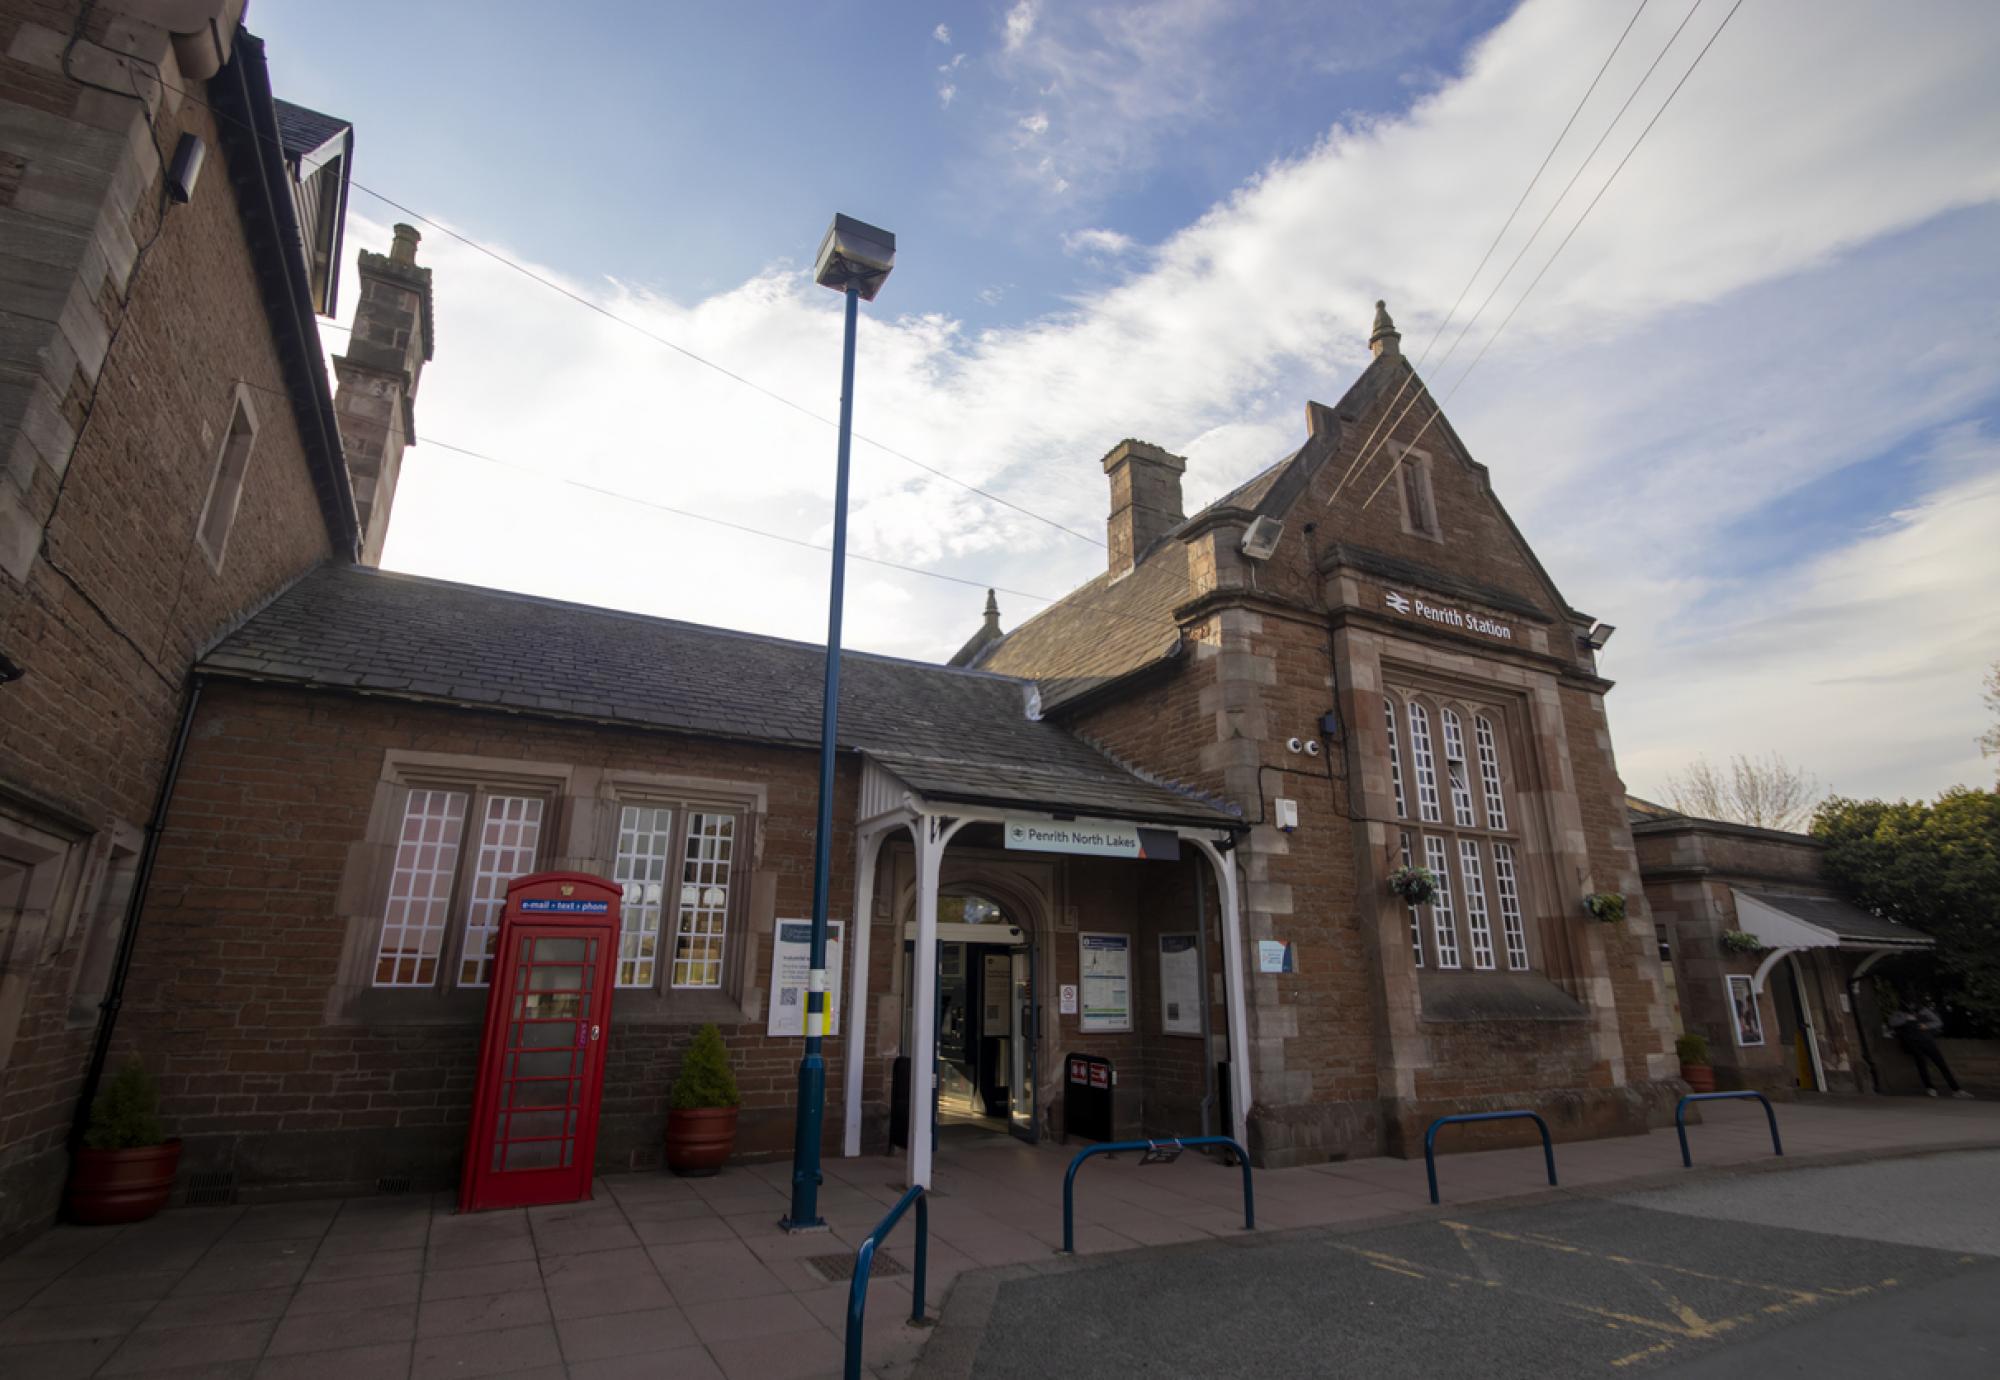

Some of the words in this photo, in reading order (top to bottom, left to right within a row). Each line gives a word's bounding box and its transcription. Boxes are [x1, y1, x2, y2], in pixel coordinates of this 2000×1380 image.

[1415, 600, 1463, 627] Penrith
[1465, 613, 1511, 639] Station
[1028, 828, 1069, 843] Penrith
[1072, 832, 1103, 846] North
[1106, 834, 1136, 848] Lakes
[522, 901, 550, 909] e-mail
[582, 902, 608, 912] phone
